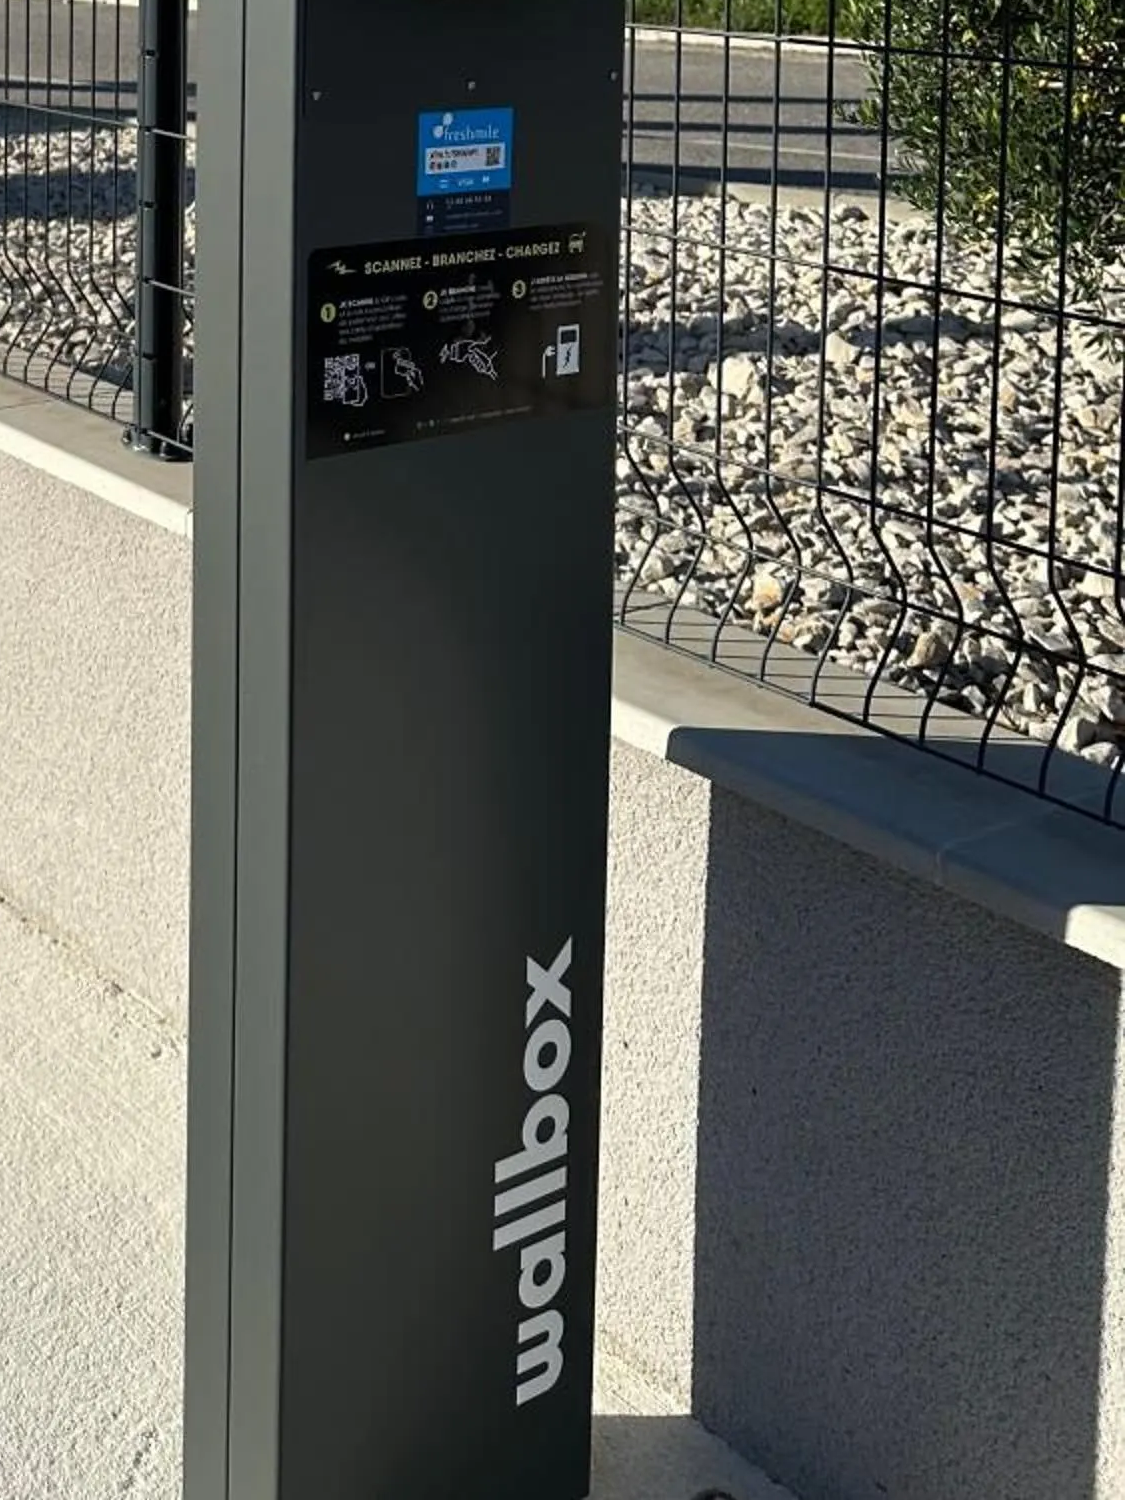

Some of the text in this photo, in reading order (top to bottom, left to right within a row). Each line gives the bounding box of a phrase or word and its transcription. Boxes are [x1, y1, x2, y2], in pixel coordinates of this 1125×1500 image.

[364, 255, 422, 275] SCANNEZ
[432, 248, 496, 268] BRANCHEZ
[505, 241, 561, 260] CHARGEZ
[493, 934, 573, 1407] wallbox
